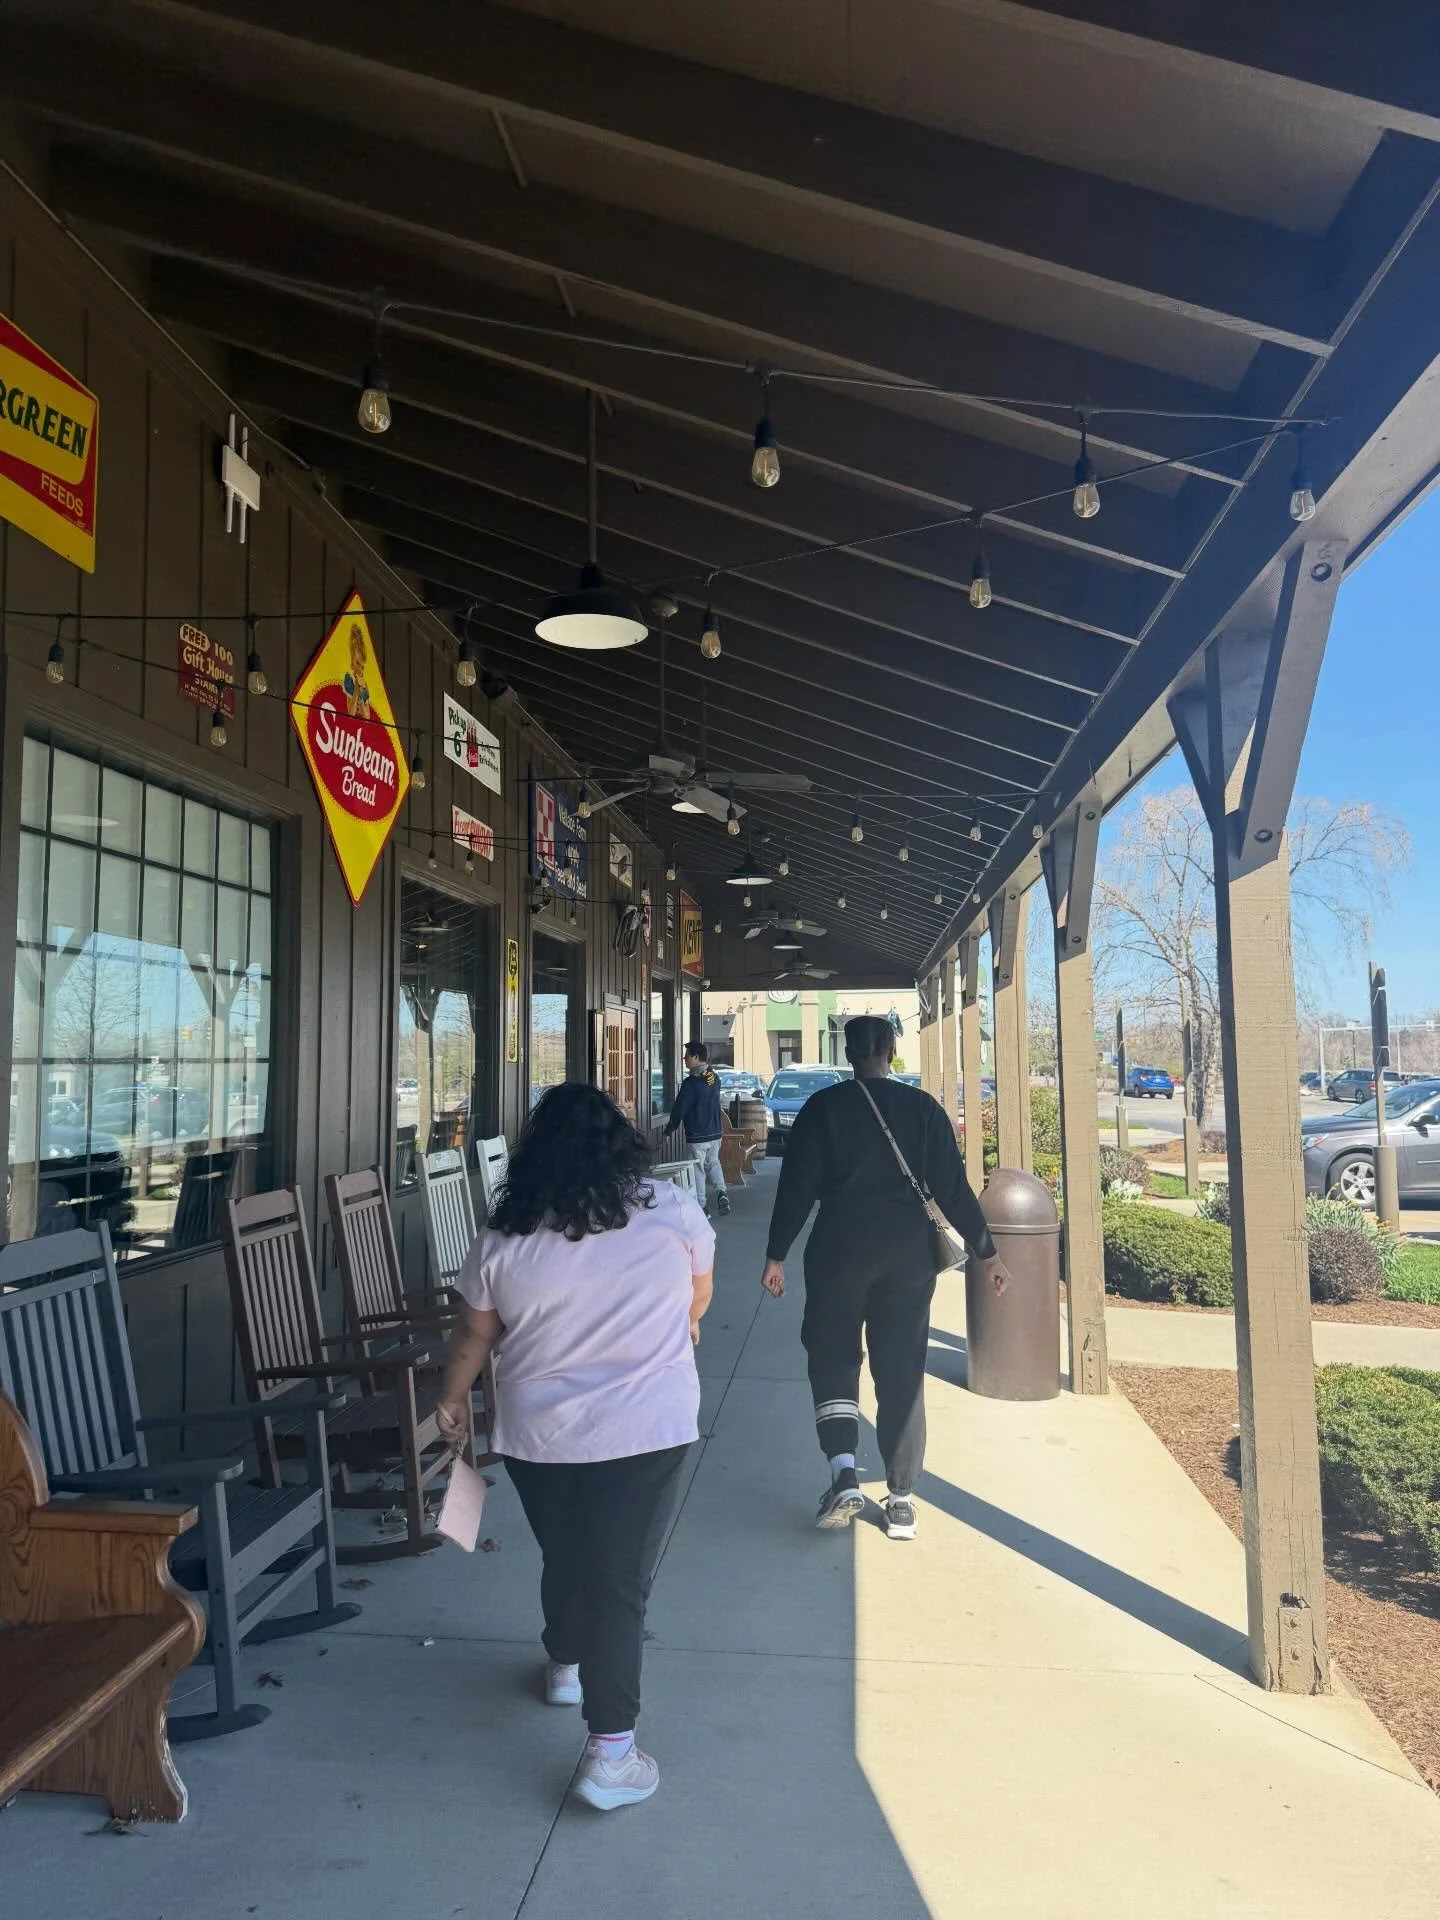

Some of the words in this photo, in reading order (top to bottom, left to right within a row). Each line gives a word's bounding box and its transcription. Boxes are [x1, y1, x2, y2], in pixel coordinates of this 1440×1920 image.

[41, 472, 84, 517] FEEDS
[182, 624, 207, 648] FREE
[214, 642, 234, 666] 100
[183, 646, 205, 673] Gift
[316, 701, 395, 787] Sunbeam
[454, 730, 462, 758] 6
[341, 766, 376, 807] Bread
